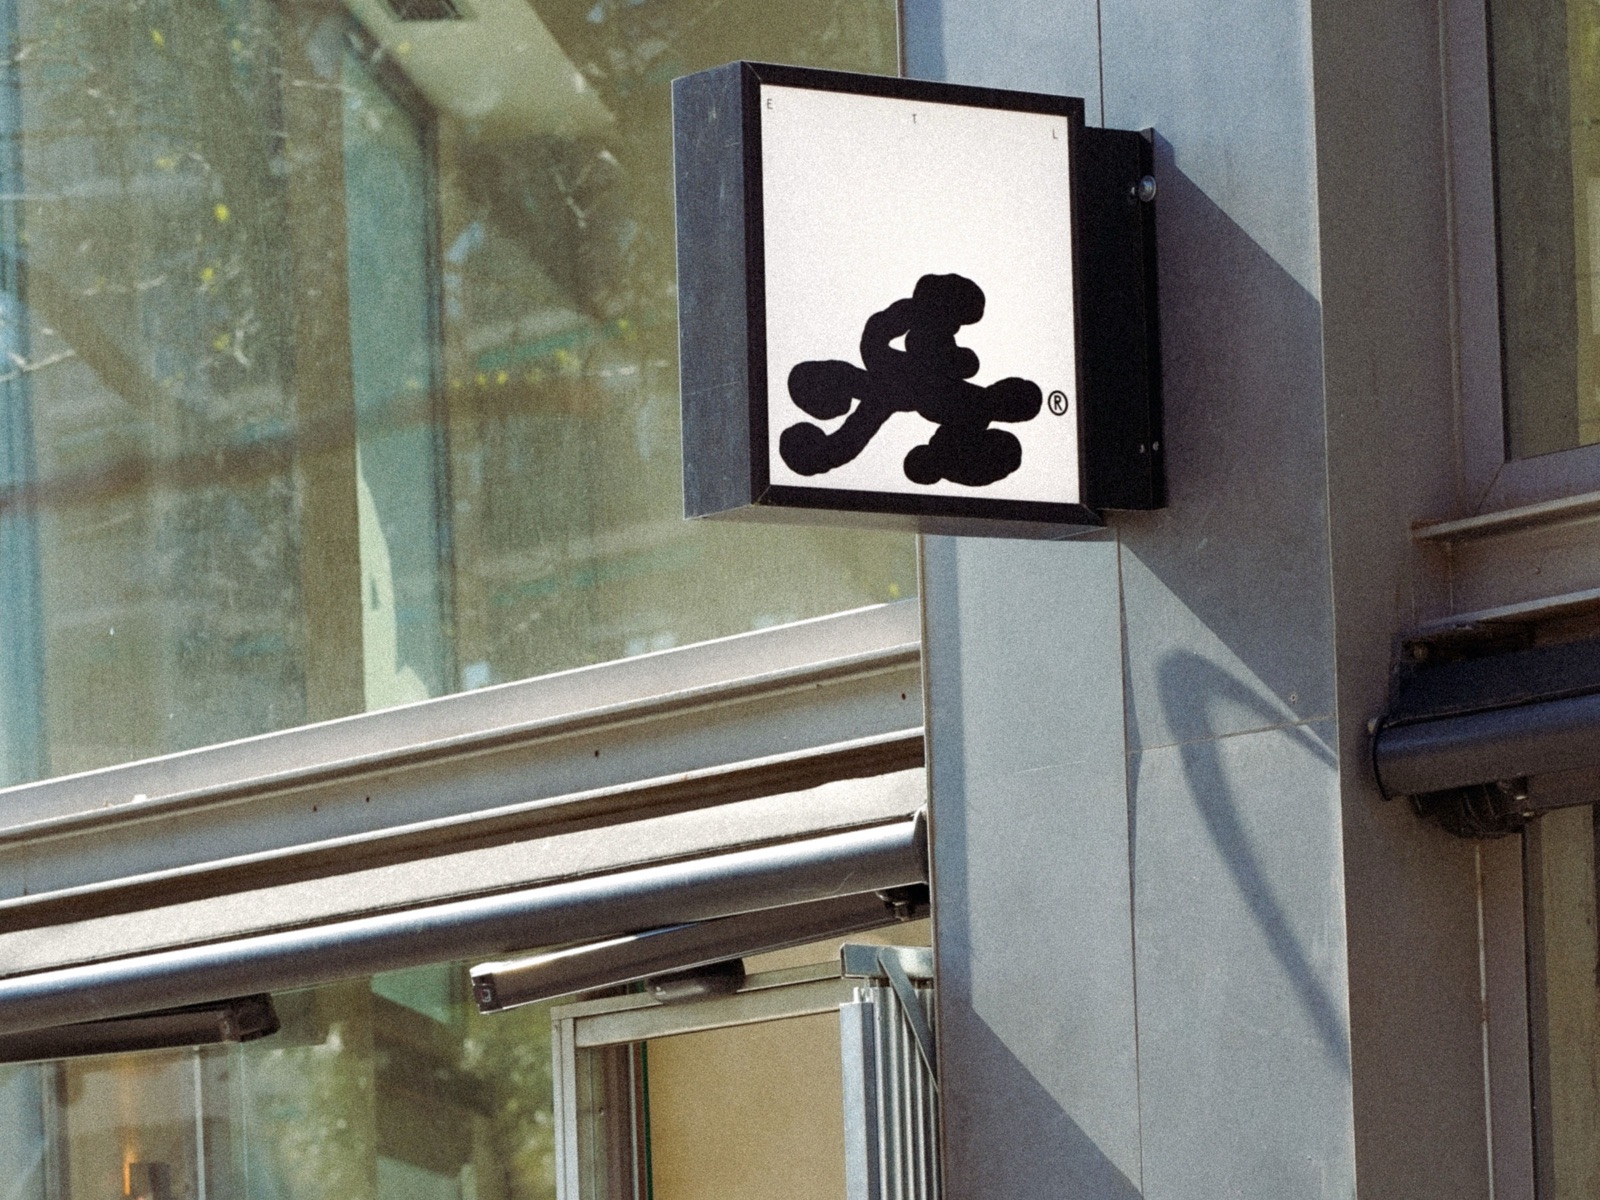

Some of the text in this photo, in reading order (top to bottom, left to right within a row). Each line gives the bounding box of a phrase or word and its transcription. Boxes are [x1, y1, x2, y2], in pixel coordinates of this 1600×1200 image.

[766, 98, 1060, 140] E T L
